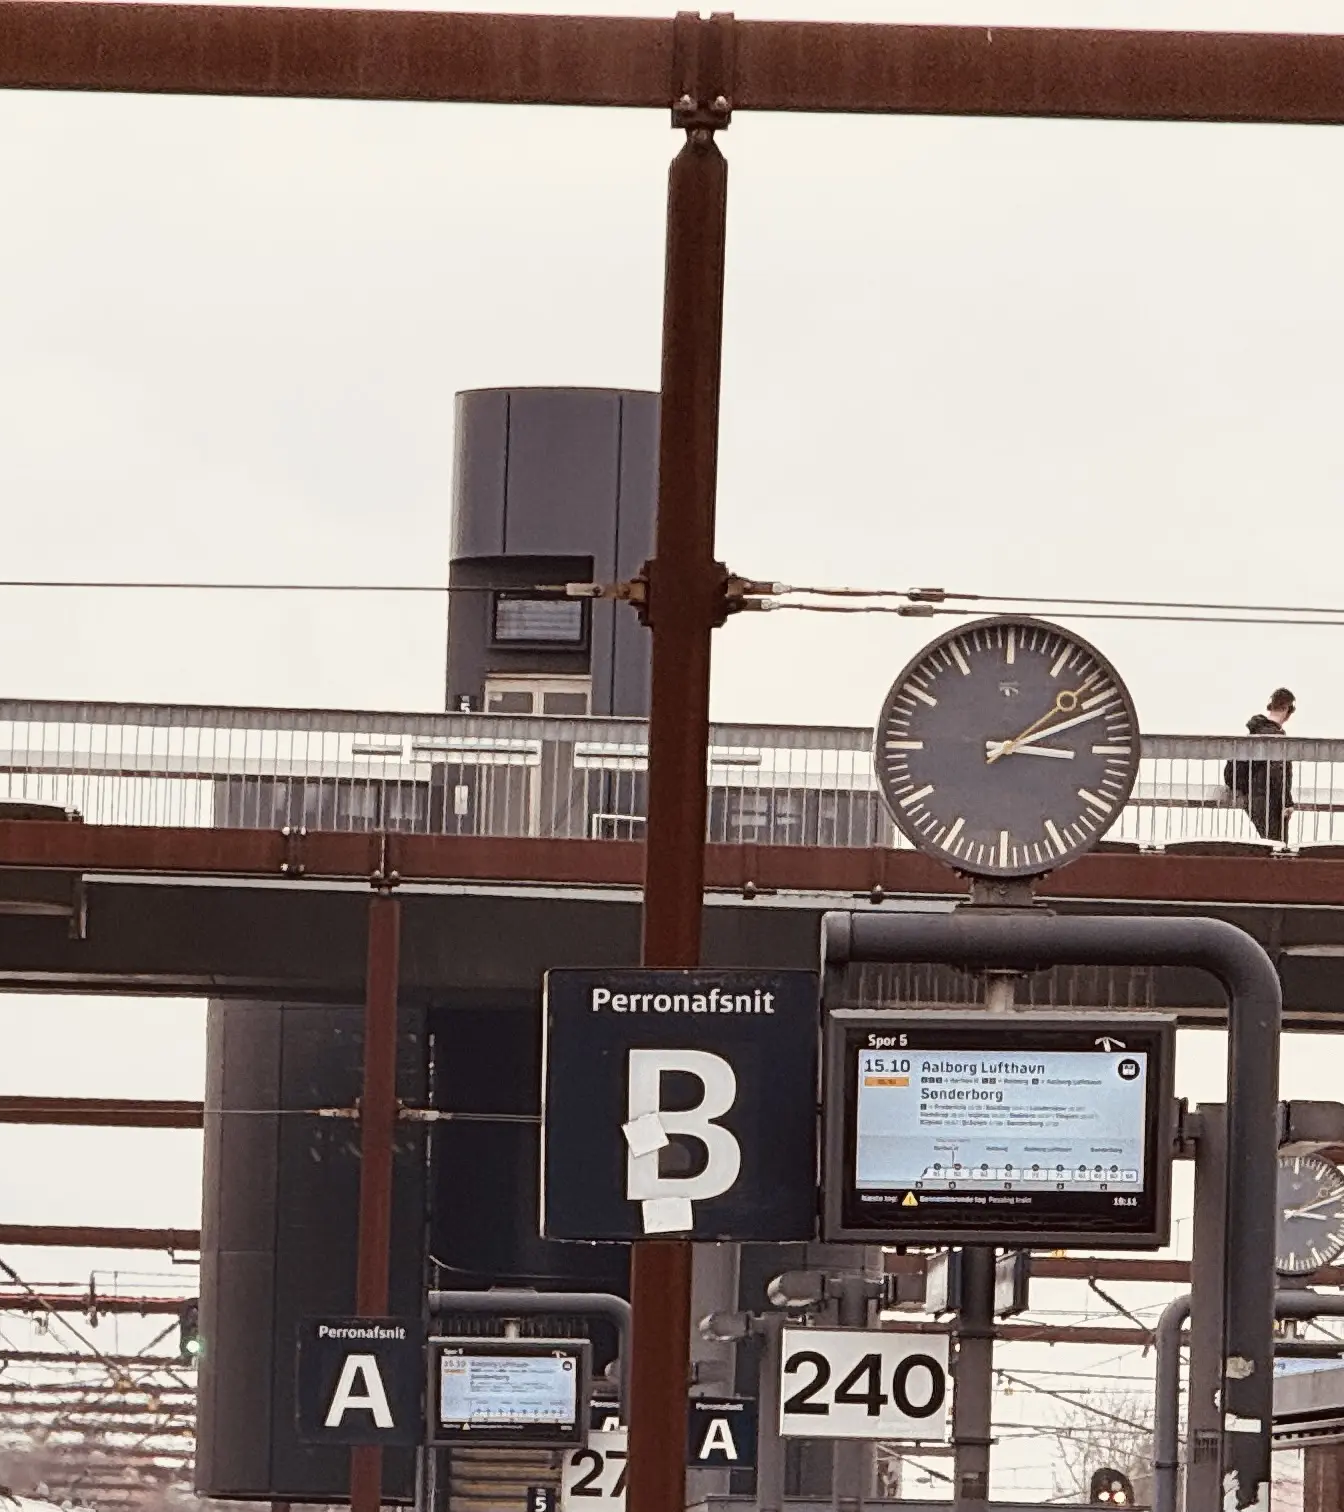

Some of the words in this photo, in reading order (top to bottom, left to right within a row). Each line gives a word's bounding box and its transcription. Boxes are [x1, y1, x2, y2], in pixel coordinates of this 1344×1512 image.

[592, 988, 775, 1014] Perronafsnit
[868, 1034, 896, 1050] Spor
[899, 1034, 908, 1046] 5
[864, 1059, 911, 1073] 15.10
[921, 1061, 977, 1075] Aalborg
[981, 1061, 1045, 1075] Lufthavn
[920, 1088, 1003, 1102] Sønderborg
[627, 1049, 741, 1201] B
[319, 1325, 406, 1340] Perronafsnit
[324, 1354, 395, 1429] A
[783, 1350, 946, 1419] 240
[698, 1418, 739, 1461] A
[534, 1497, 547, 1512] 5
